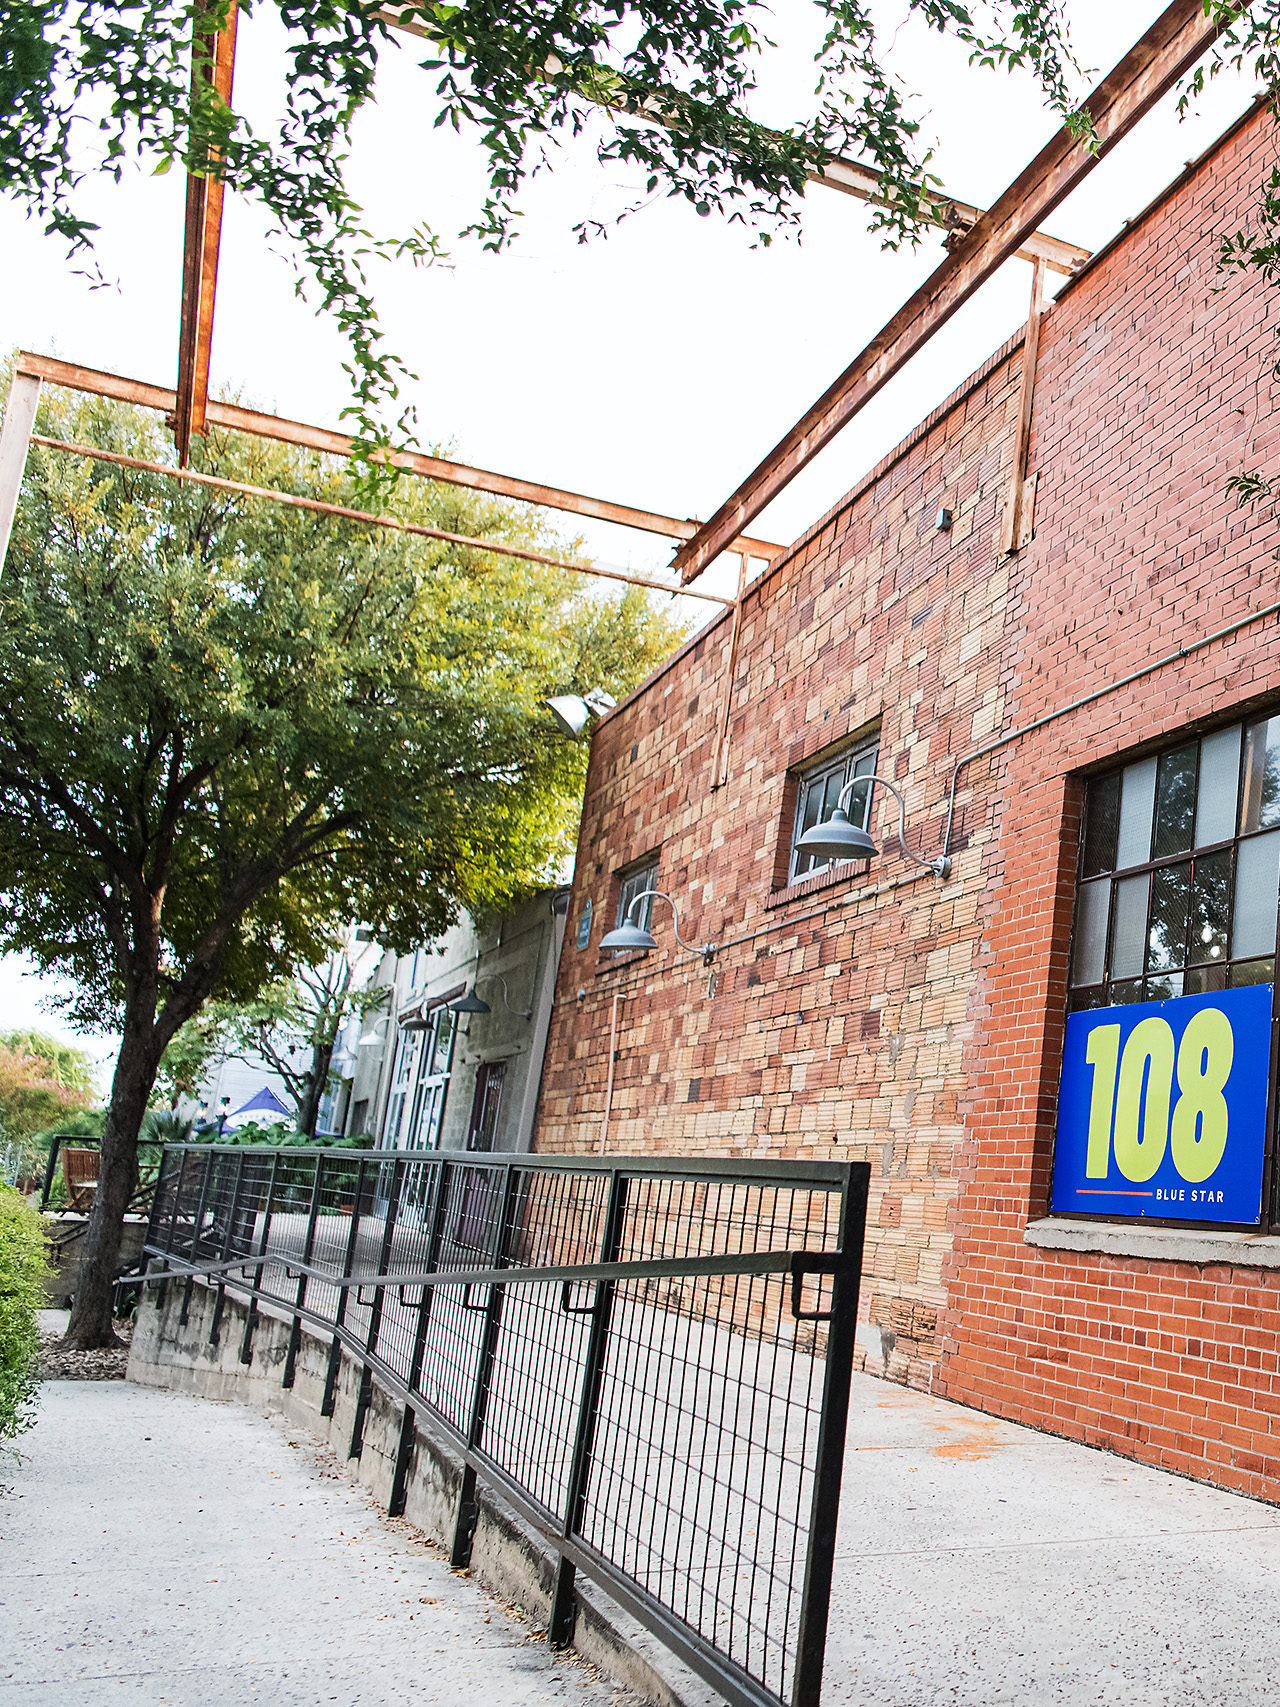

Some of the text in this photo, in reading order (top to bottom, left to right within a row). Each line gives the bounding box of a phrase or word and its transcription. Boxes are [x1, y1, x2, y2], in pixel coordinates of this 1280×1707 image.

[1086, 1007, 1234, 1183] 108
[1156, 1188, 1224, 1203] BLUE STAR
